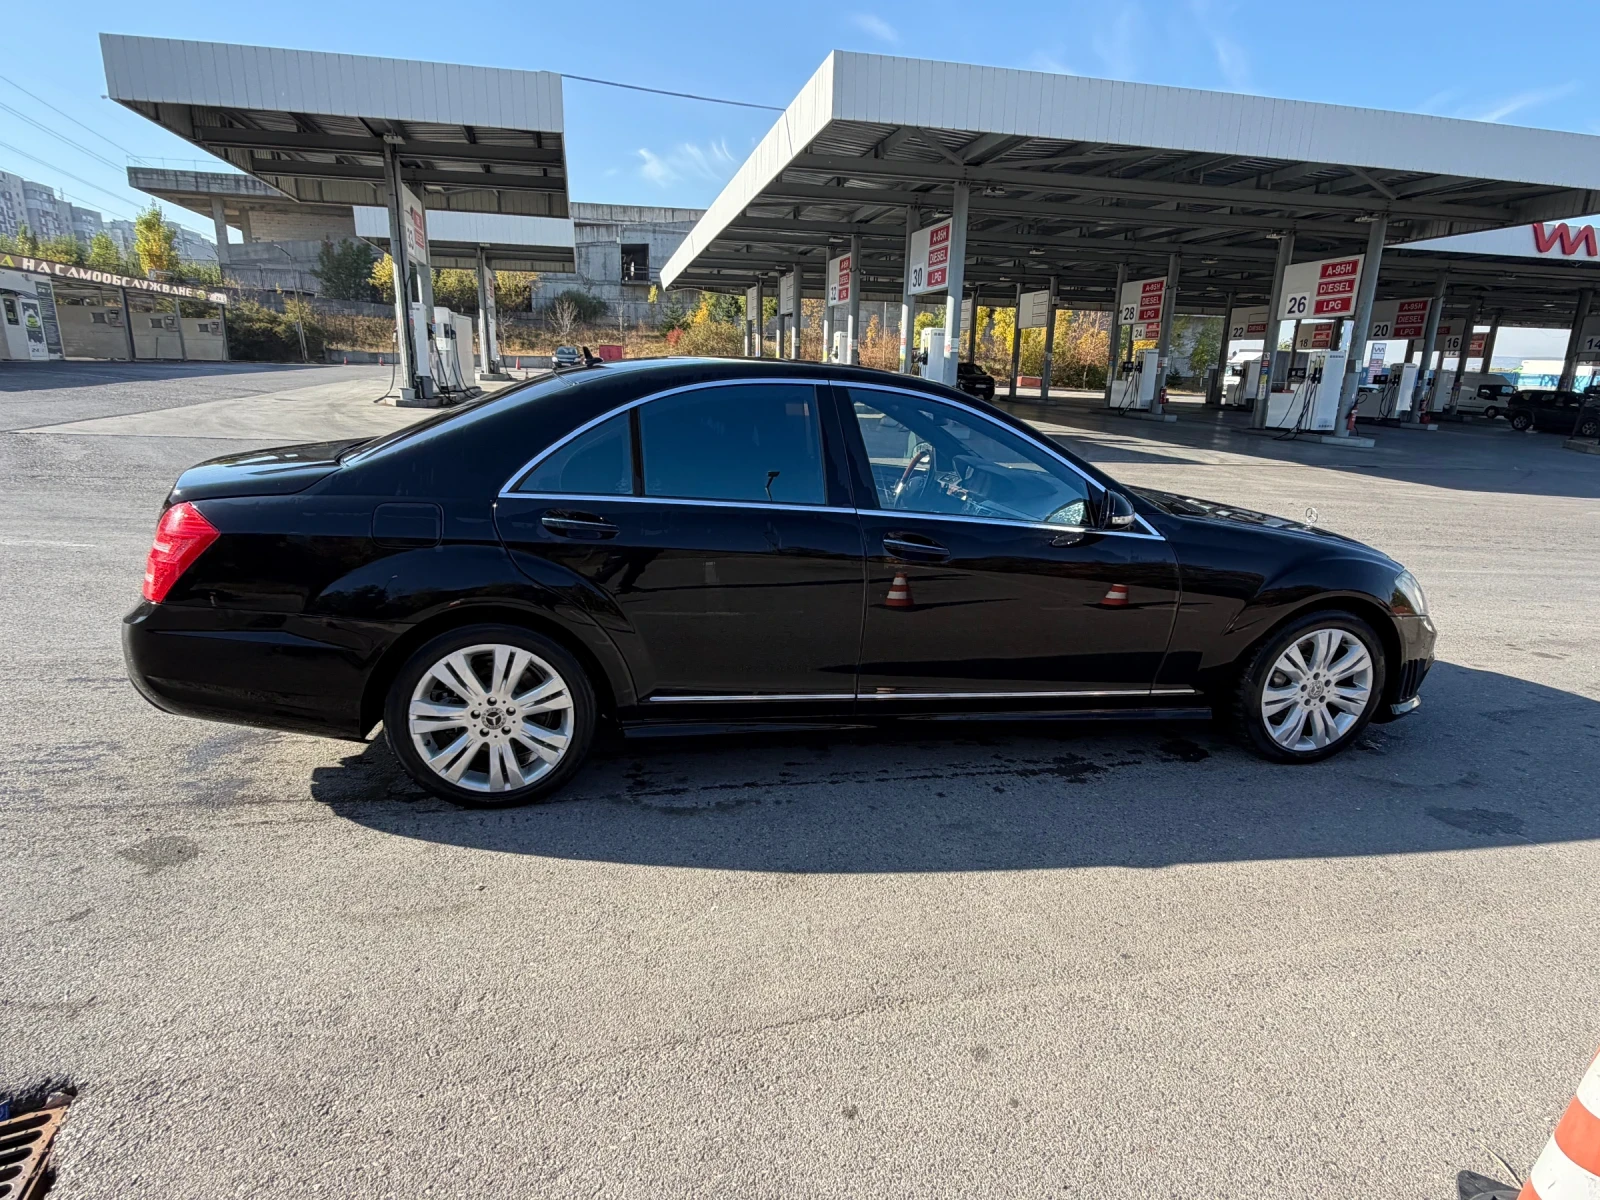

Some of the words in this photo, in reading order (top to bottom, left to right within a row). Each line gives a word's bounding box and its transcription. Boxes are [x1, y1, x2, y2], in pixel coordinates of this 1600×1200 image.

[929, 249, 947, 264] DIESEL
[1326, 263, 1352, 276] A-95H
[23, 258, 51, 274] НА
[55, 264, 193, 296] САМООБСЛУЖВАНЕ
[912, 267, 923, 288] 30
[931, 271, 942, 283] LPG
[1320, 282, 1351, 293] DIESEL
[1142, 296, 1160, 305] DIESEL
[1287, 295, 1307, 314] 26
[1323, 300, 1342, 311] LPG
[1123, 306, 1135, 320] 28
[1143, 310, 1155, 318] LPG
[1397, 315, 1422, 323] DIESEL
[1233, 327, 1244, 338] 22
[1373, 324, 1389, 337] 20
[1446, 337, 1460, 349] 16
[1587, 337, 1600, 350] 14
